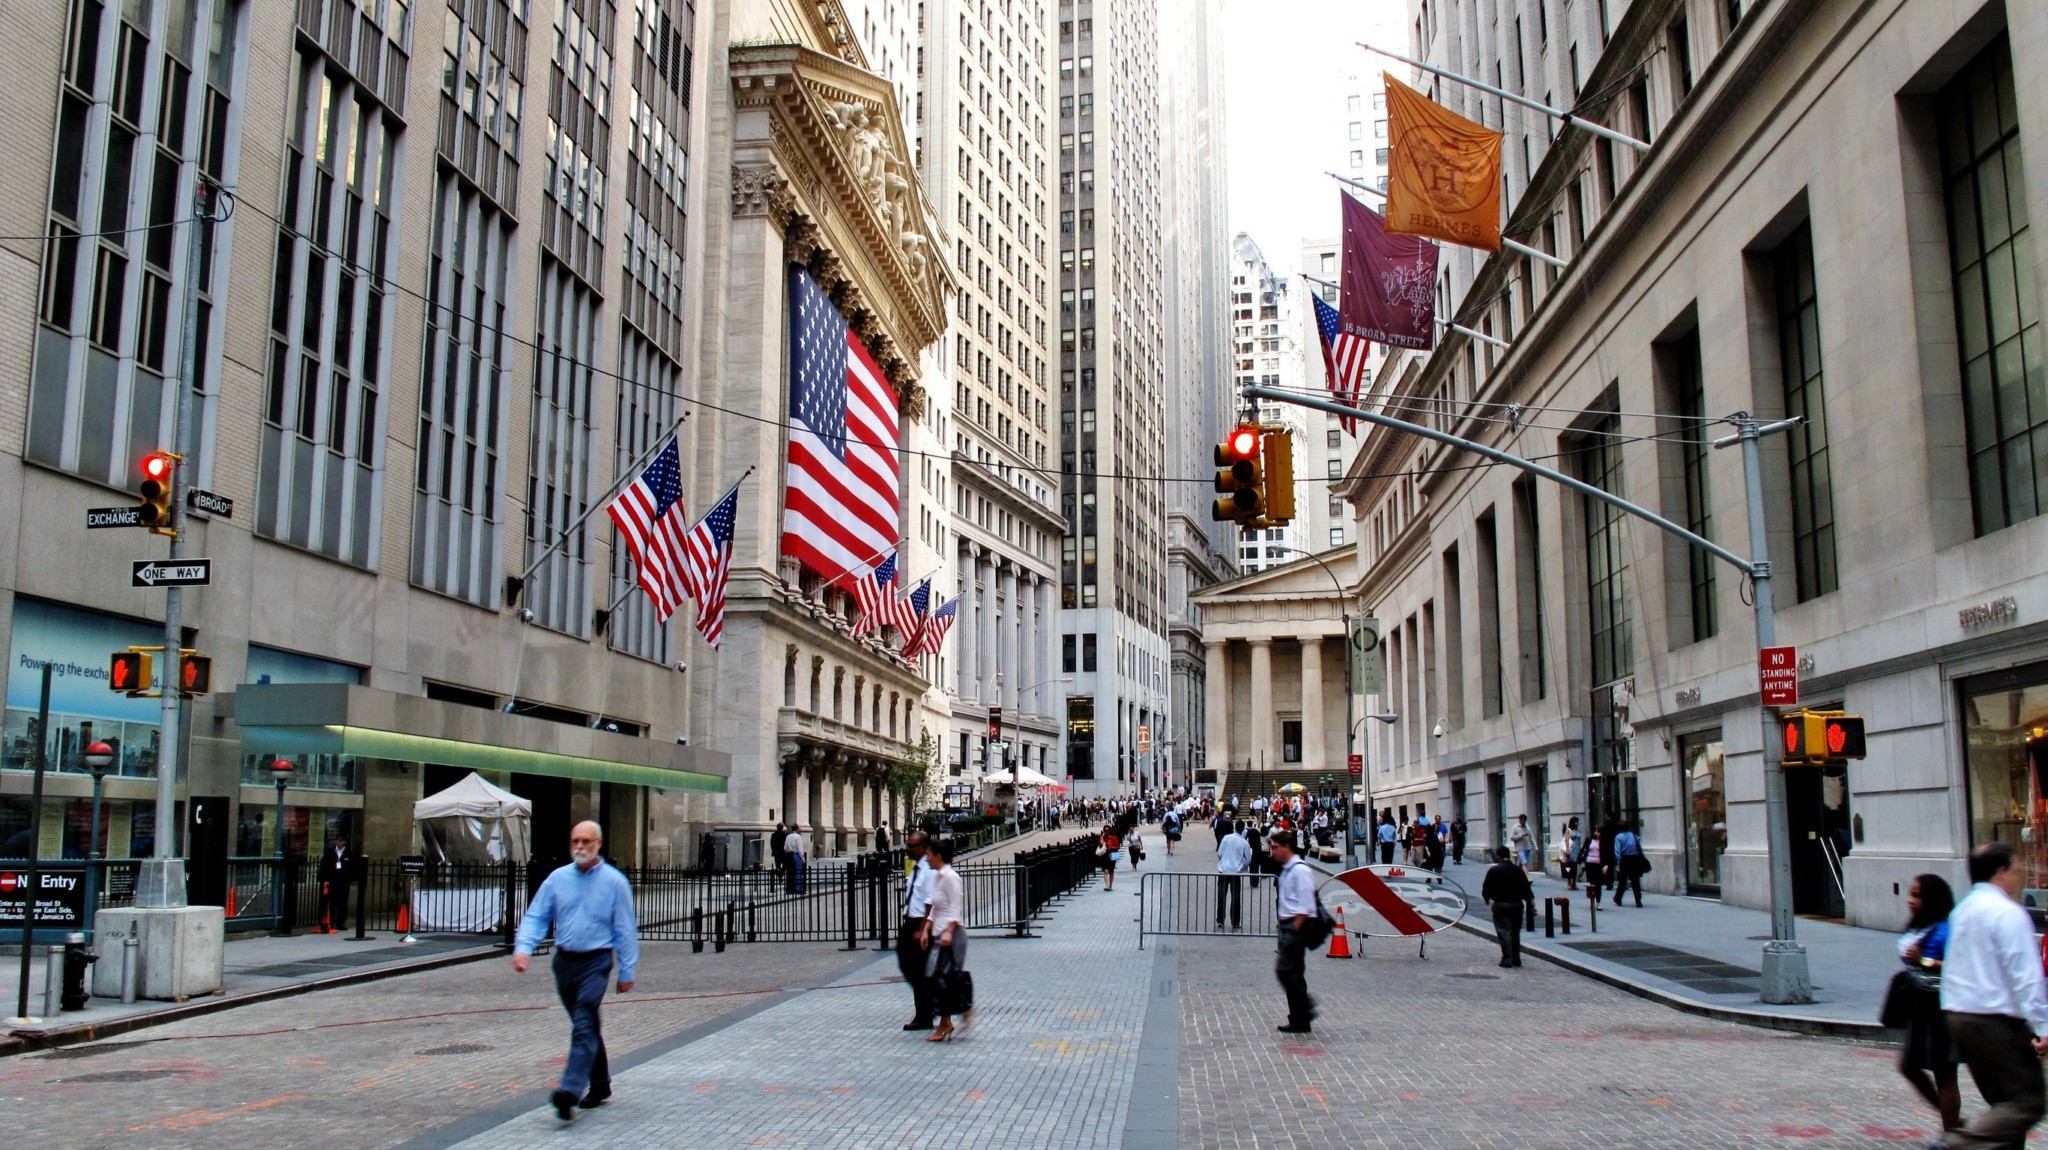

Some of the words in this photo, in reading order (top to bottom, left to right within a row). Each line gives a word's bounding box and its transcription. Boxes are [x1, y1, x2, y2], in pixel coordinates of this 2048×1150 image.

[1430, 164, 1459, 195] H
[1345, 322, 1354, 333] 15
[1356, 325, 1386, 341] BROAD
[1388, 333, 1425, 348] STREET
[200, 495, 227, 513] BROAD
[88, 511, 137, 525] EXCHANGE
[144, 568, 166, 579] ONE
[176, 567, 201, 578] WAY
[1772, 653, 1784, 665] NO
[67, 662, 82, 677] the
[1762, 668, 1795, 679] STANDING
[1764, 680, 1794, 690] ANYTIME
[17, 875, 28, 888] N
[41, 874, 77, 890] Entry
